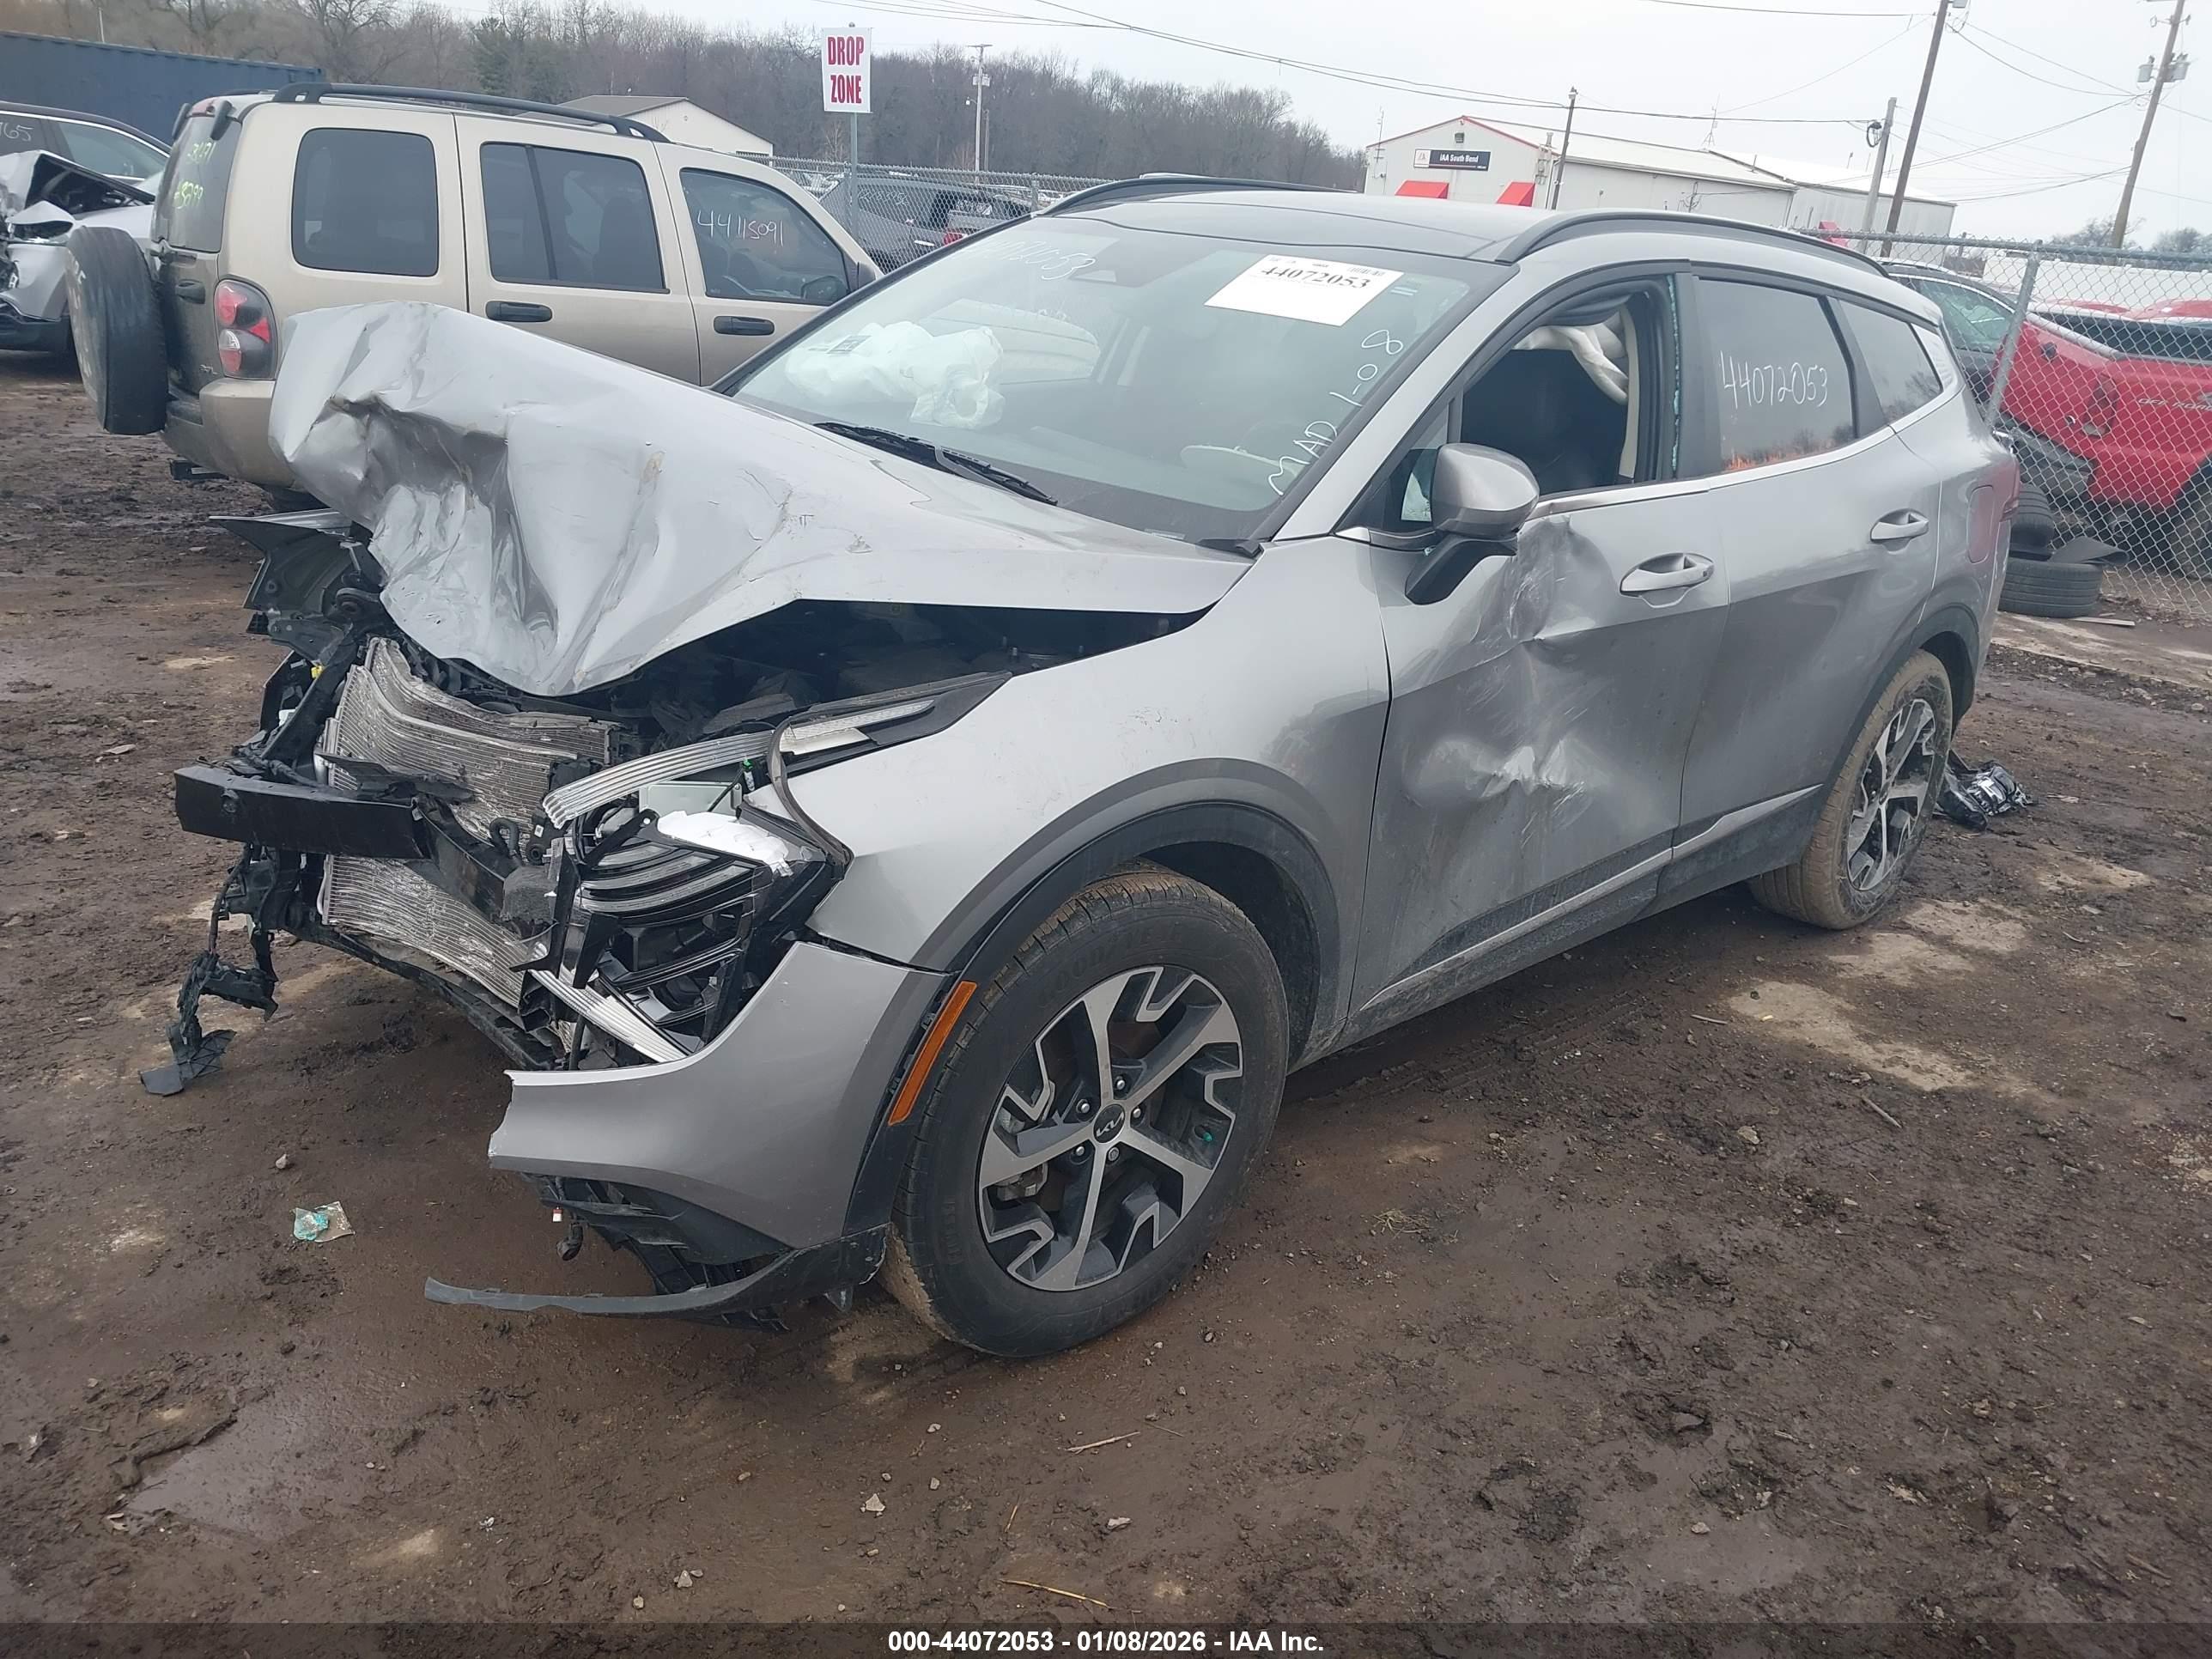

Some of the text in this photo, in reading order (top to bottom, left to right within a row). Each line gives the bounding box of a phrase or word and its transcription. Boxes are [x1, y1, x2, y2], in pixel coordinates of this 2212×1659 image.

[827, 36, 865, 66] DROP
[830, 74, 862, 104] ZONE
[1439, 153, 1479, 163] IAA South Bend
[697, 210, 784, 247] 44115091
[1261, 265, 1372, 289] 44072053
[1719, 349, 1828, 410] 44072053
[1267, 420, 1338, 496] MAD
